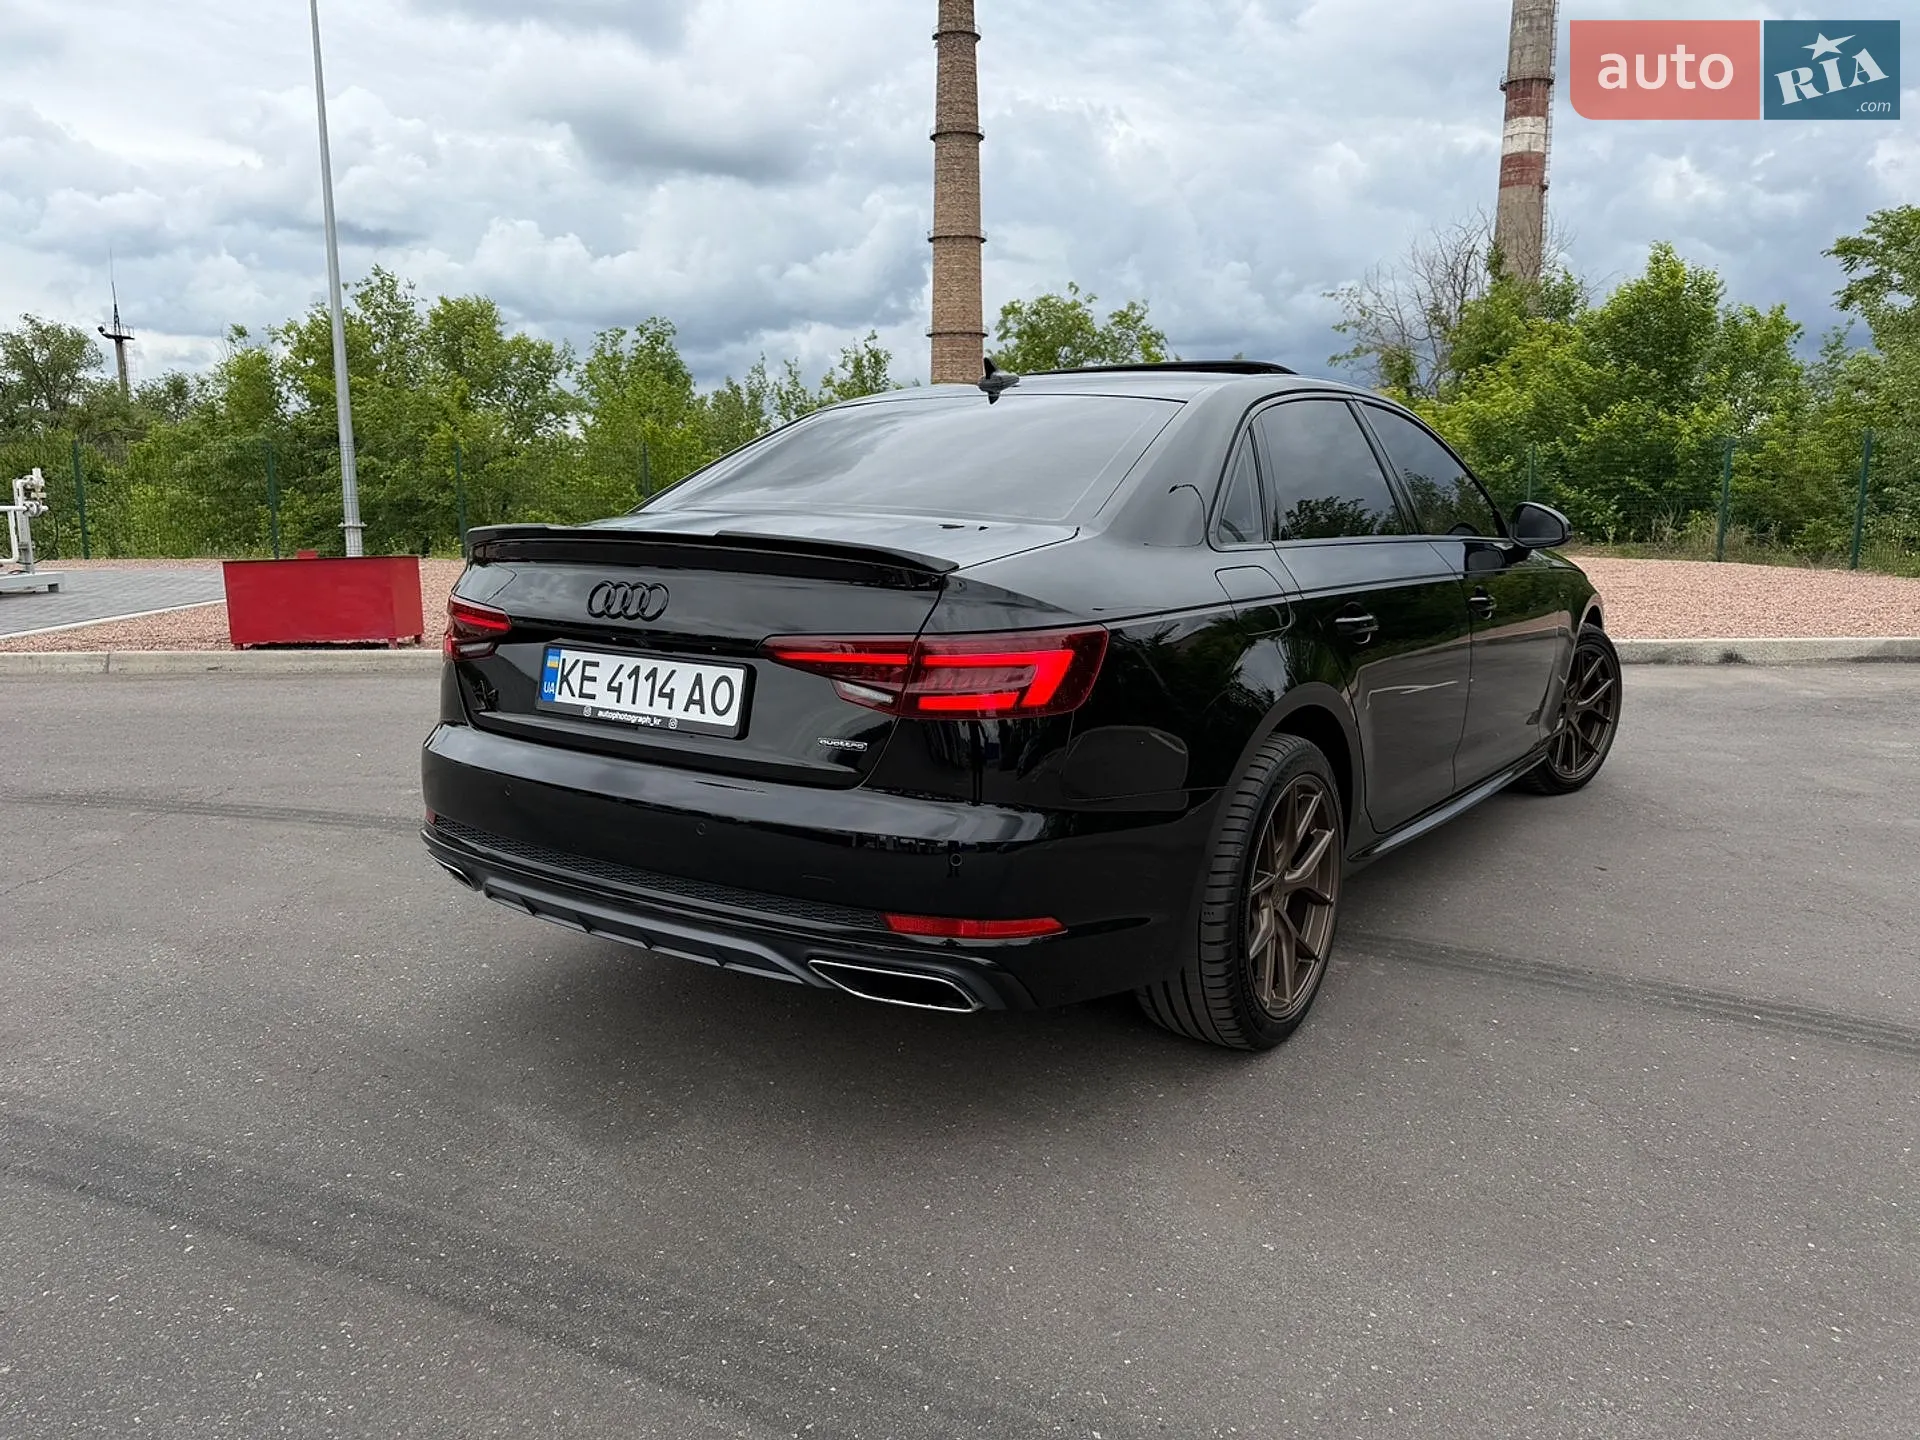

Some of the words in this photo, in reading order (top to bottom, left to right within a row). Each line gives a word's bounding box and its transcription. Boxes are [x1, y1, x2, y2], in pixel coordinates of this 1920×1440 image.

[543, 681, 556, 695] UA
[558, 657, 600, 700] KE
[606, 663, 677, 710] 4114
[683, 672, 735, 717] AO
[597, 710, 662, 726] autophotograph_kr
